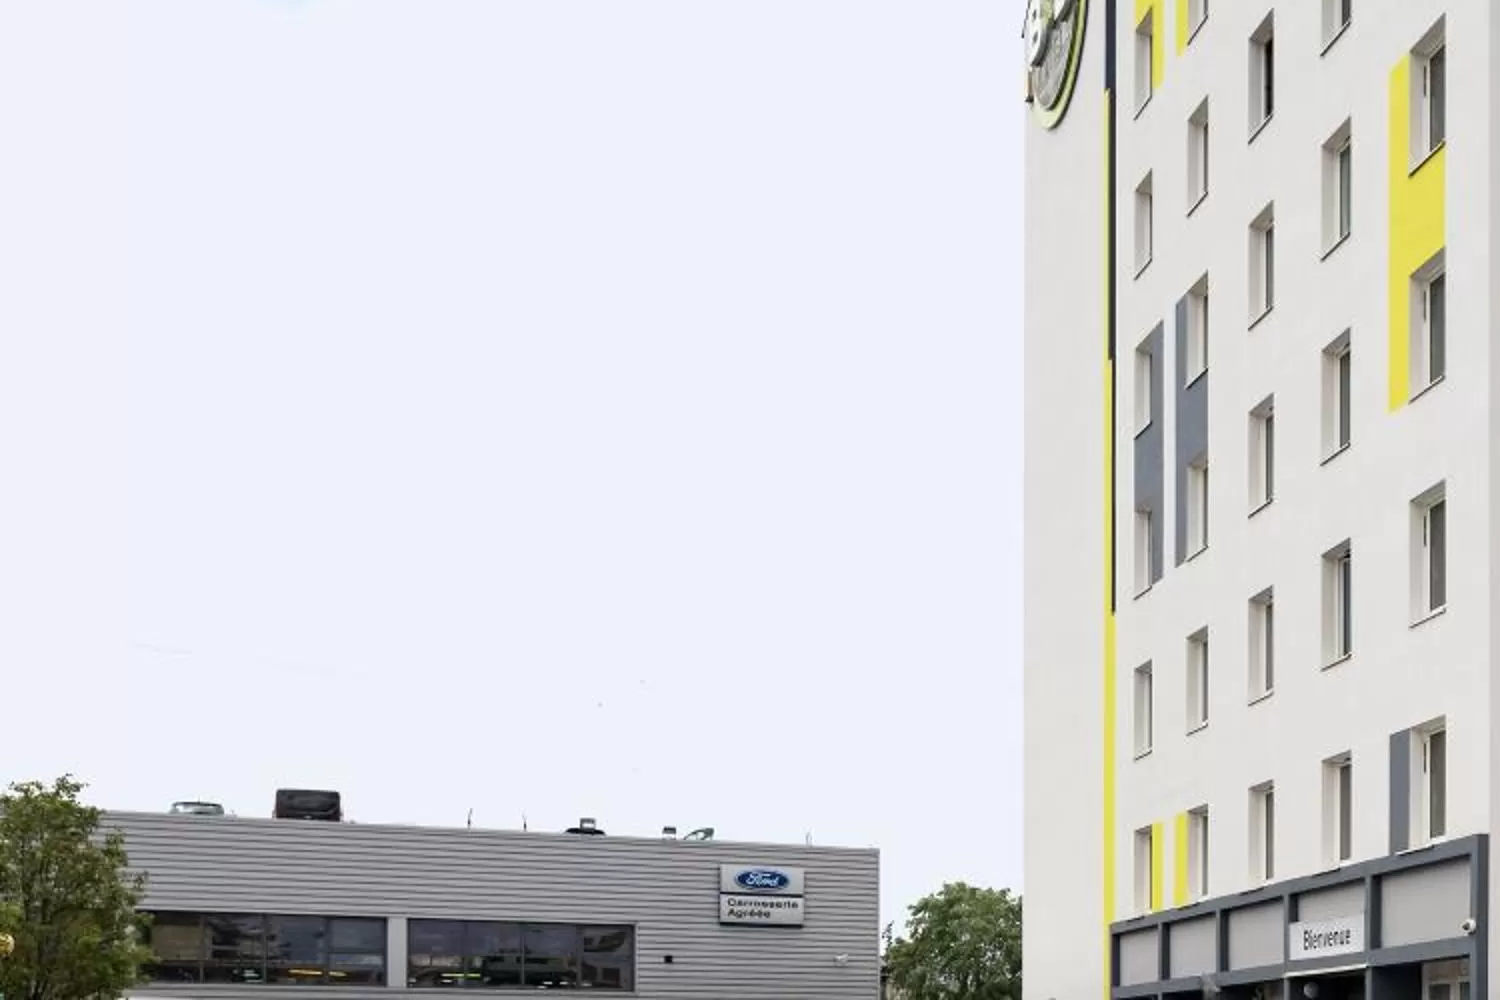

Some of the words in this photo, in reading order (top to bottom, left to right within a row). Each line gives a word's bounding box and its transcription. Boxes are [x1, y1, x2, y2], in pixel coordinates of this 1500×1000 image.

[745, 871, 780, 887] Ford
[727, 897, 799, 910] Carrosserie
[1303, 928, 1351, 951] Bienvenue
